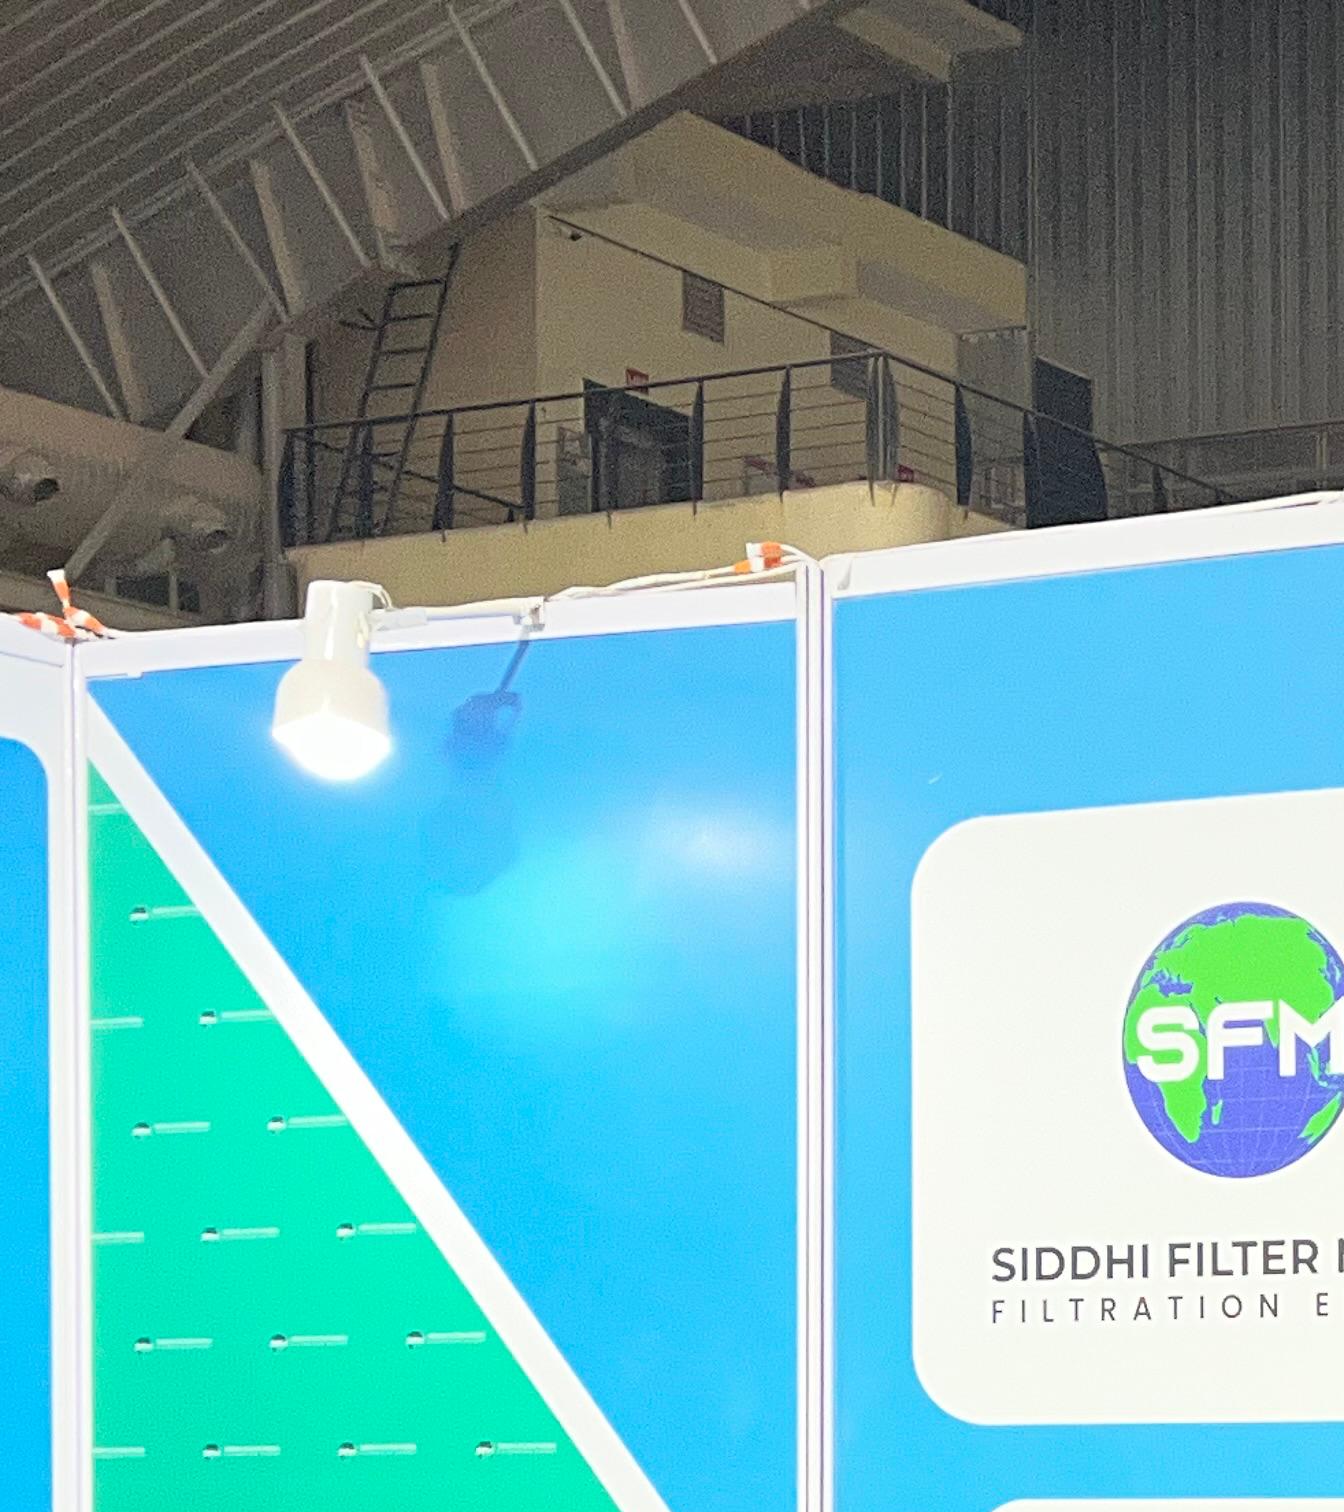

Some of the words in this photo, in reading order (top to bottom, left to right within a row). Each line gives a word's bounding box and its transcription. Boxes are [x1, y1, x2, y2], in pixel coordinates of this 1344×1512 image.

[991, 1243, 1150, 1281] SIDDHI
[1168, 1239, 1319, 1277] FILTER
[991, 1292, 1279, 1324] FILTRATION
